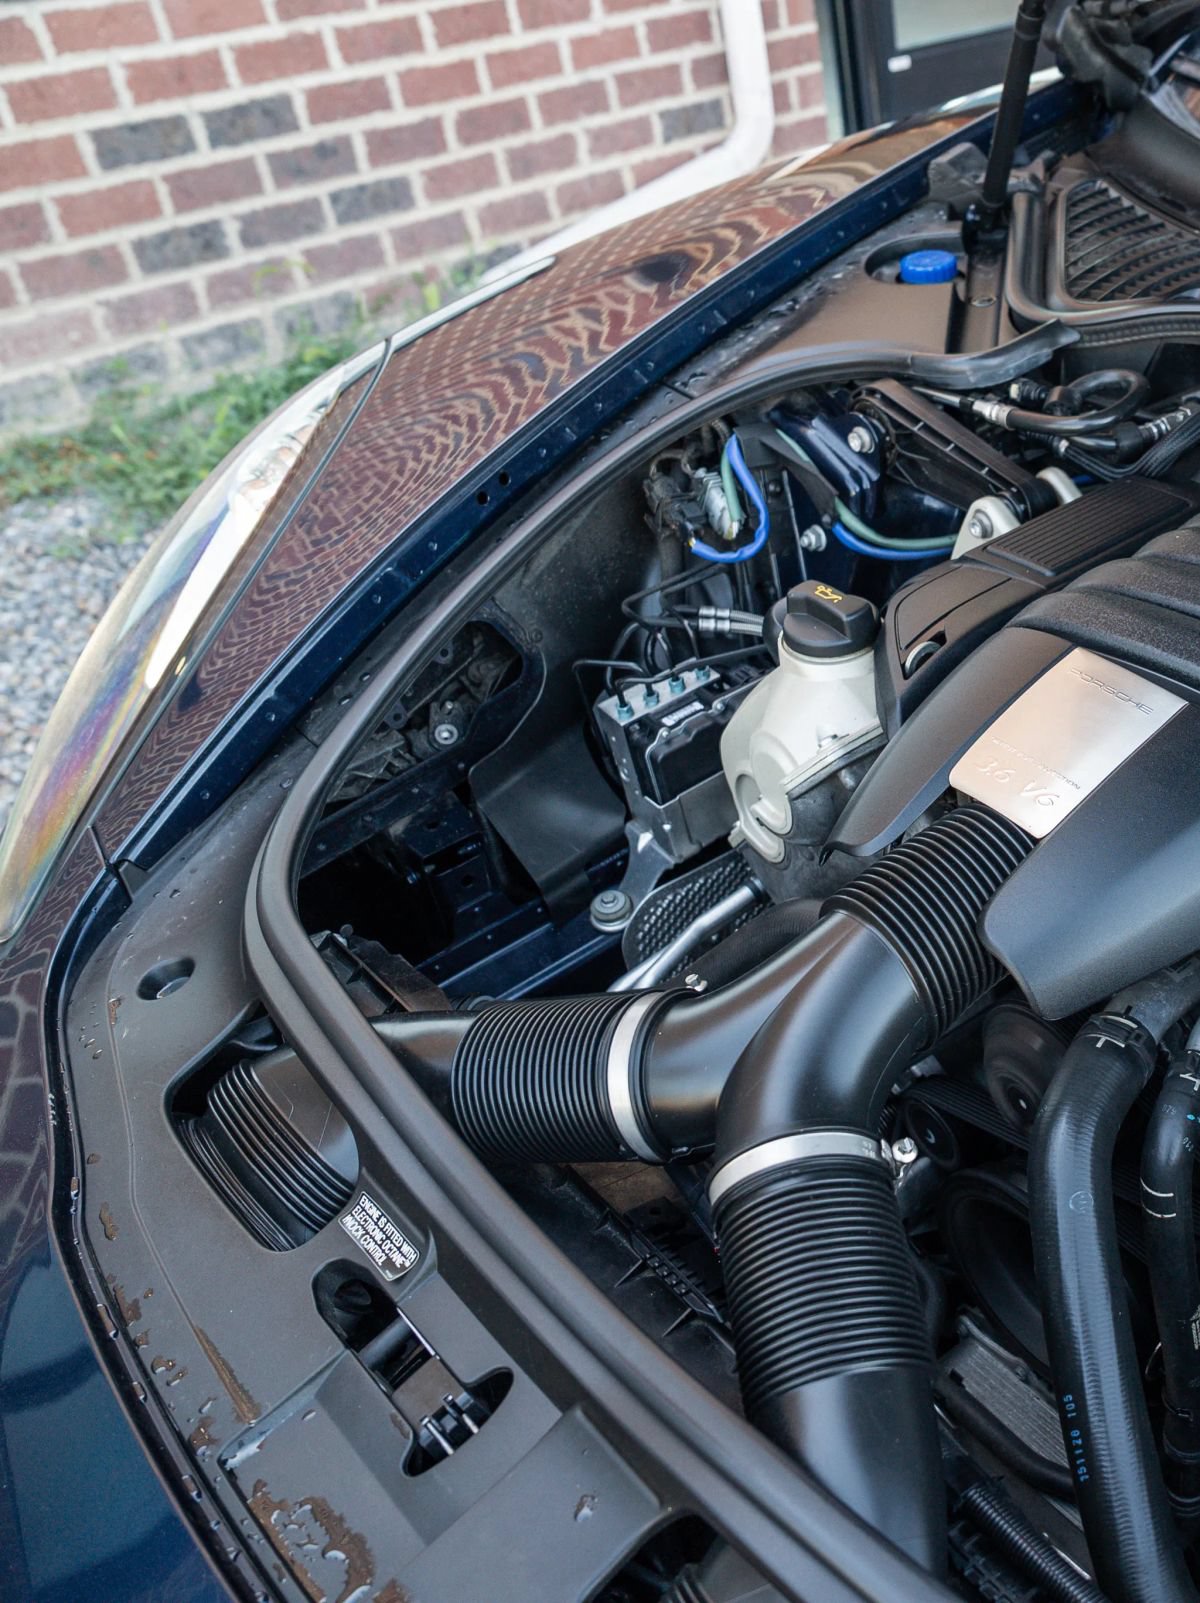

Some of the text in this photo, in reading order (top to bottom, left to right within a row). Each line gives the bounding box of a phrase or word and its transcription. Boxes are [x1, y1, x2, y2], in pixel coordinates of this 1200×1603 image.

[1067, 667, 1155, 716] PORSCHE
[974, 758, 1060, 807] 3.6 V6
[342, 1214, 388, 1266] KNOCK CONTROL
[352, 1206, 386, 1243] ELECTRONIC
[360, 1195, 381, 1222] ENGINE
[378, 1216, 387, 1228] IS
[383, 1220, 404, 1247] FITTED
[399, 1241, 417, 1261] WITH
[1063, 1394, 1077, 1418] 105
